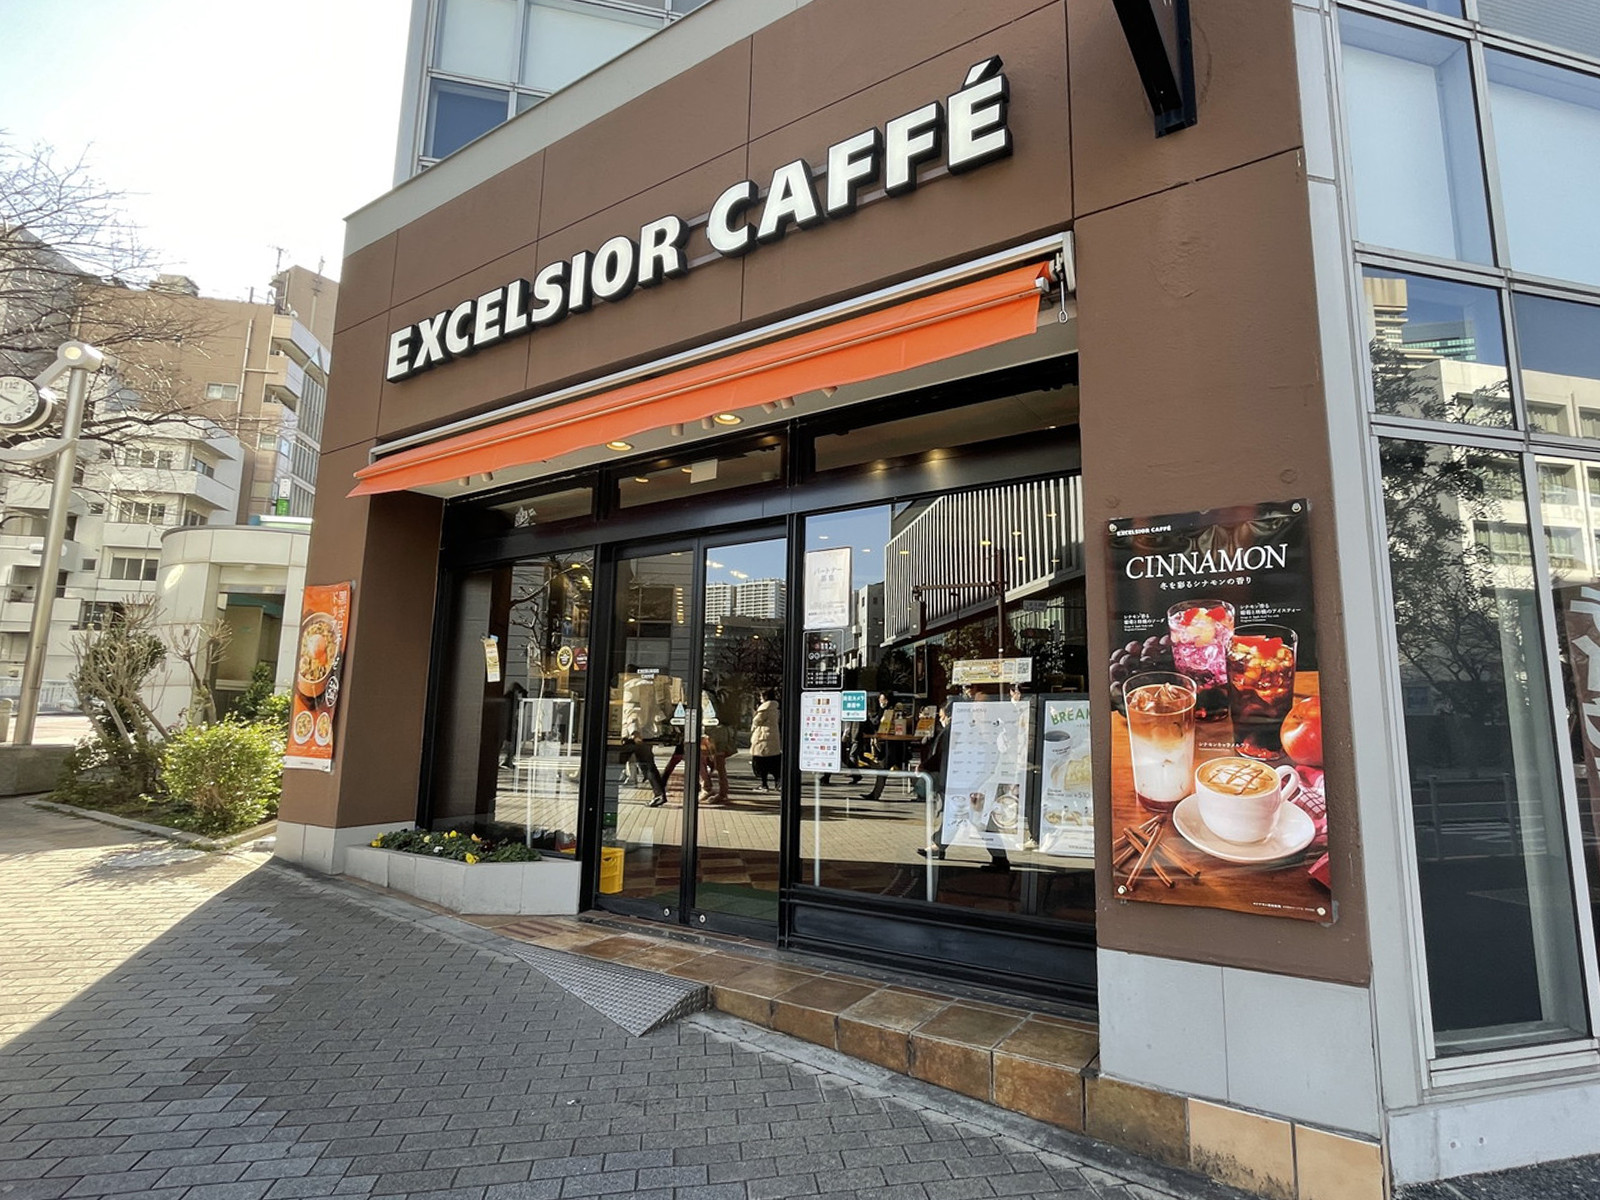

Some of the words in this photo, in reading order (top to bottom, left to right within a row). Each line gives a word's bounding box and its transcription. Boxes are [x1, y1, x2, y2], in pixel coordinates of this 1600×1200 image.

[386, 214, 687, 384] EXCELSIOR
[706, 55, 1013, 258] CAFFÉ
[1116, 528, 1150, 537] EXCELSIOR
[1125, 543, 1289, 580] CINNAMON
[1160, 576, 1252, 591] 冬を彩るシナモンの香り
